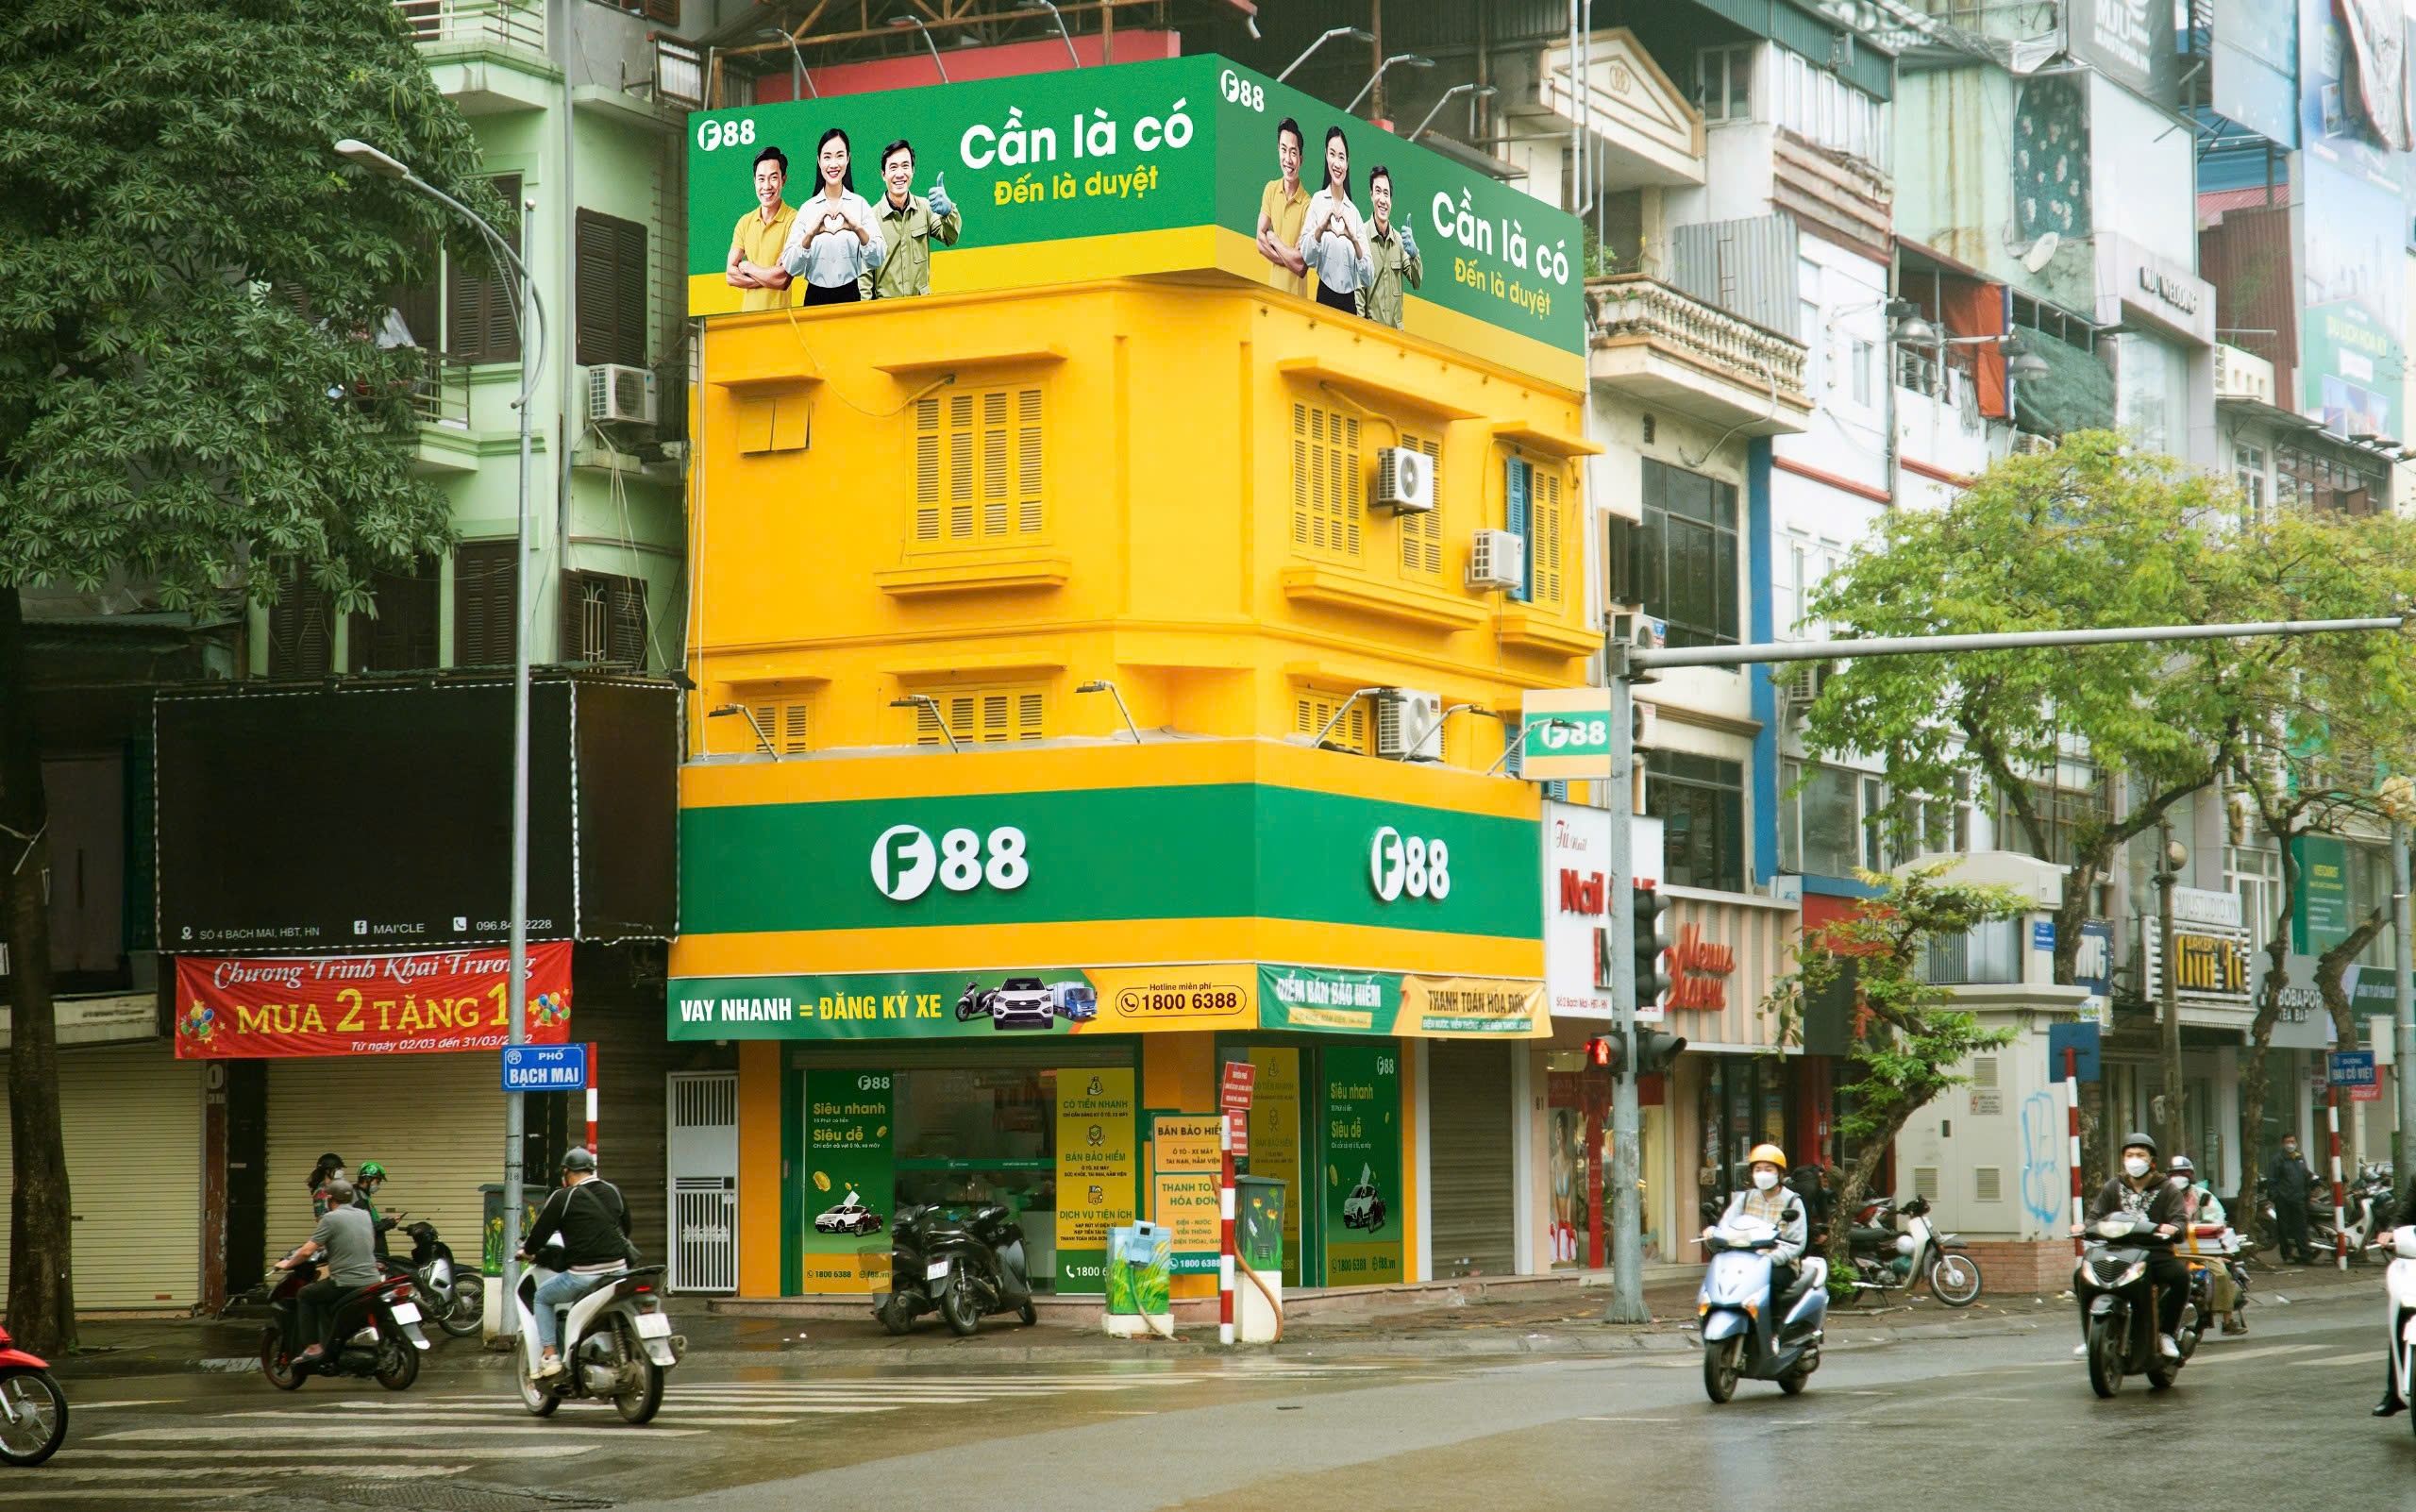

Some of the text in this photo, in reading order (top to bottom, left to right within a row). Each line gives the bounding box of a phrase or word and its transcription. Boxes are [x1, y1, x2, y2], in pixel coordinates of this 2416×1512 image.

[1221, 69, 1265, 112] F88
[697, 119, 756, 152] F88
[960, 97, 1194, 170] Cần là có
[995, 164, 1159, 206] Đến là duyệt
[1433, 186, 1569, 285] Cần là có
[1455, 257, 1551, 321] Đến là duyệt
[1541, 718, 1607, 748] F88
[870, 824, 1029, 901] F88
[1371, 826, 1451, 901] F88
[217, 930, 223, 939] 4
[280, 927, 303, 937] HBT,
[305, 927, 320, 937] HN
[214, 952, 536, 990] Chương Trình Khai Trươg
[1149, 983, 1177, 991] Hotline
[237, 983, 510, 1036] MUA 2 TẶNG 1
[680, 1000, 716, 1022] VAY
[721, 998, 792, 1021] NHANH
[819, 990, 877, 1020] ĐĂNG
[882, 988, 908, 1017] KÝ
[915, 995, 942, 1017] XE
[1142, 992, 1237, 1012] 1800 6388
[1428, 990, 1458, 1012] THANH
[1461, 988, 1485, 1013] TOÁN
[1487, 989, 1506, 1014] HÓA
[351, 1041, 366, 1051] Từ
[367, 1040, 396, 1052] ngày
[399, 1038, 435, 1050] 02/03
[438, 1036, 461, 1049] đến
[538, 1048, 564, 1061] PHỐ
[1377, 1056, 1394, 1075] F88
[510, 1067, 579, 1087] BẠCH MAI
[858, 1075, 890, 1091] F88
[1331, 1082, 1373, 1100] Siêu nhanh
[814, 1102, 885, 1115] Siêu nhanh
[1064, 1098, 1128, 1109] CÓ TIỀN NHANH
[814, 1126, 864, 1141] Siêu dễ
[1158, 1125, 1178, 1136] BÁN
[1181, 1124, 1201, 1136] BẢO
[1332, 1117, 1362, 1138] Siêu dễ
[1065, 1150, 1126, 1161] BÁN BẢO HIỂM
[1170, 1195, 1217, 1205] HÓA ĐƠN
[1060, 1209, 1132, 1220] DỊCH VỤ TIỆN ÍCH
[1077, 1267, 1099, 1276] 1800
[1180, 1259, 1200, 1268] 1800
